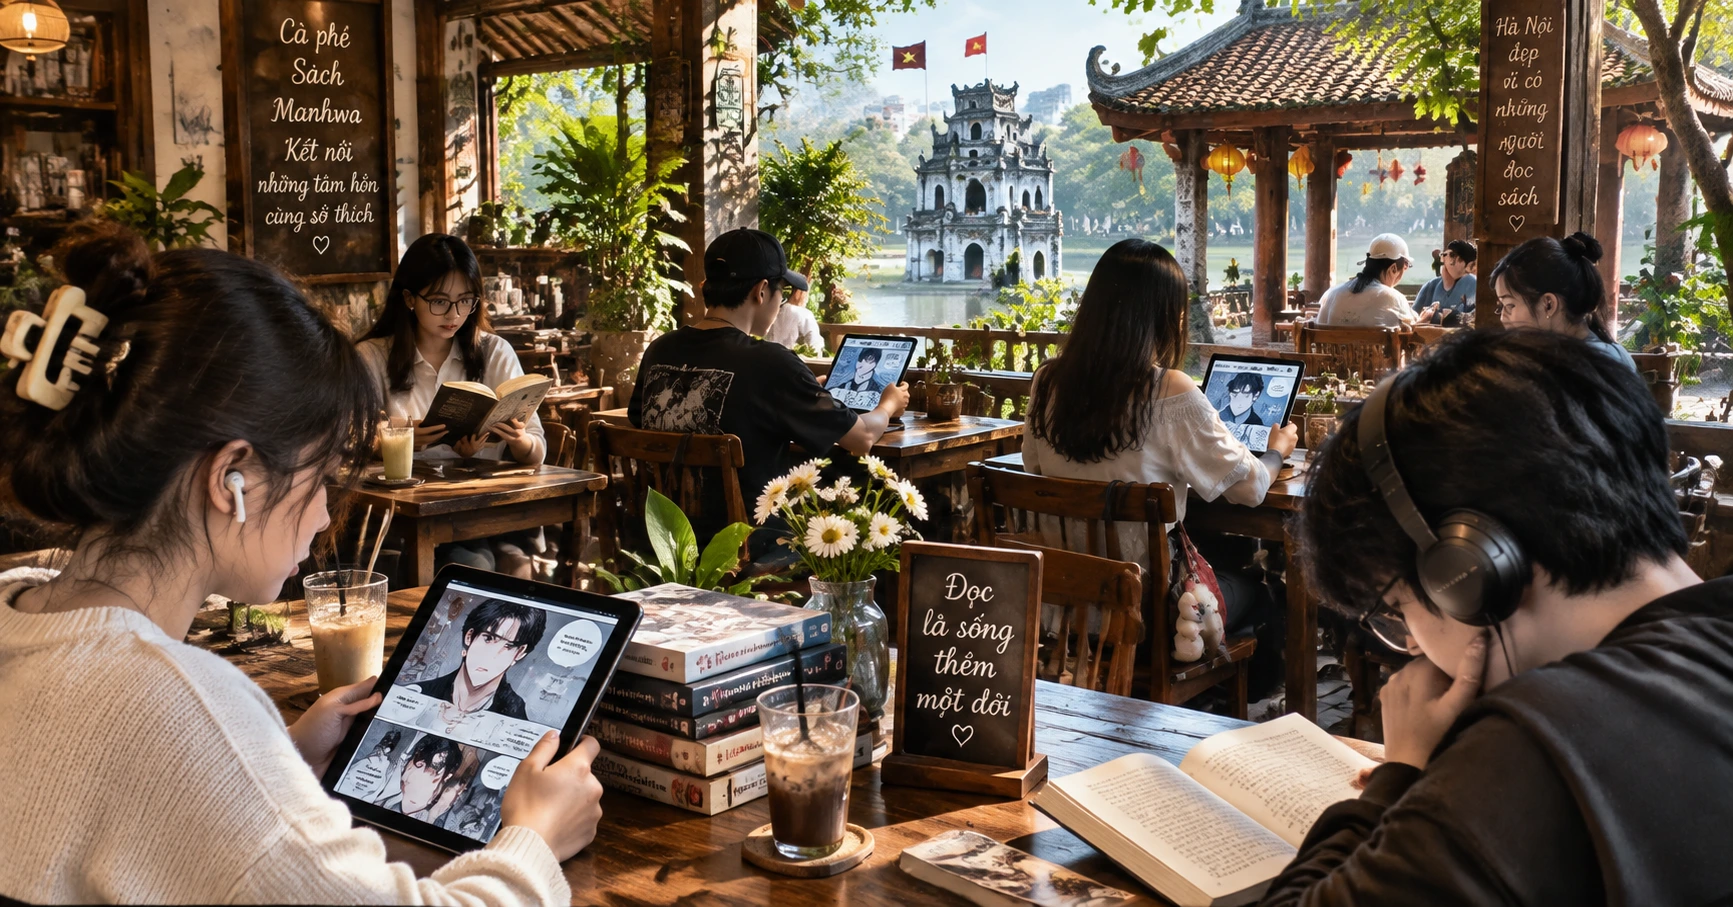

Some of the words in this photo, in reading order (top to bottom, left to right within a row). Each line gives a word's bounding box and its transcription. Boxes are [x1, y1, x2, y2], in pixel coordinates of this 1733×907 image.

[280, 17, 309, 44] Cà
[270, 96, 363, 124] Manhwa
[944, 572, 995, 609] Đọc
[956, 612, 1015, 655] sống
